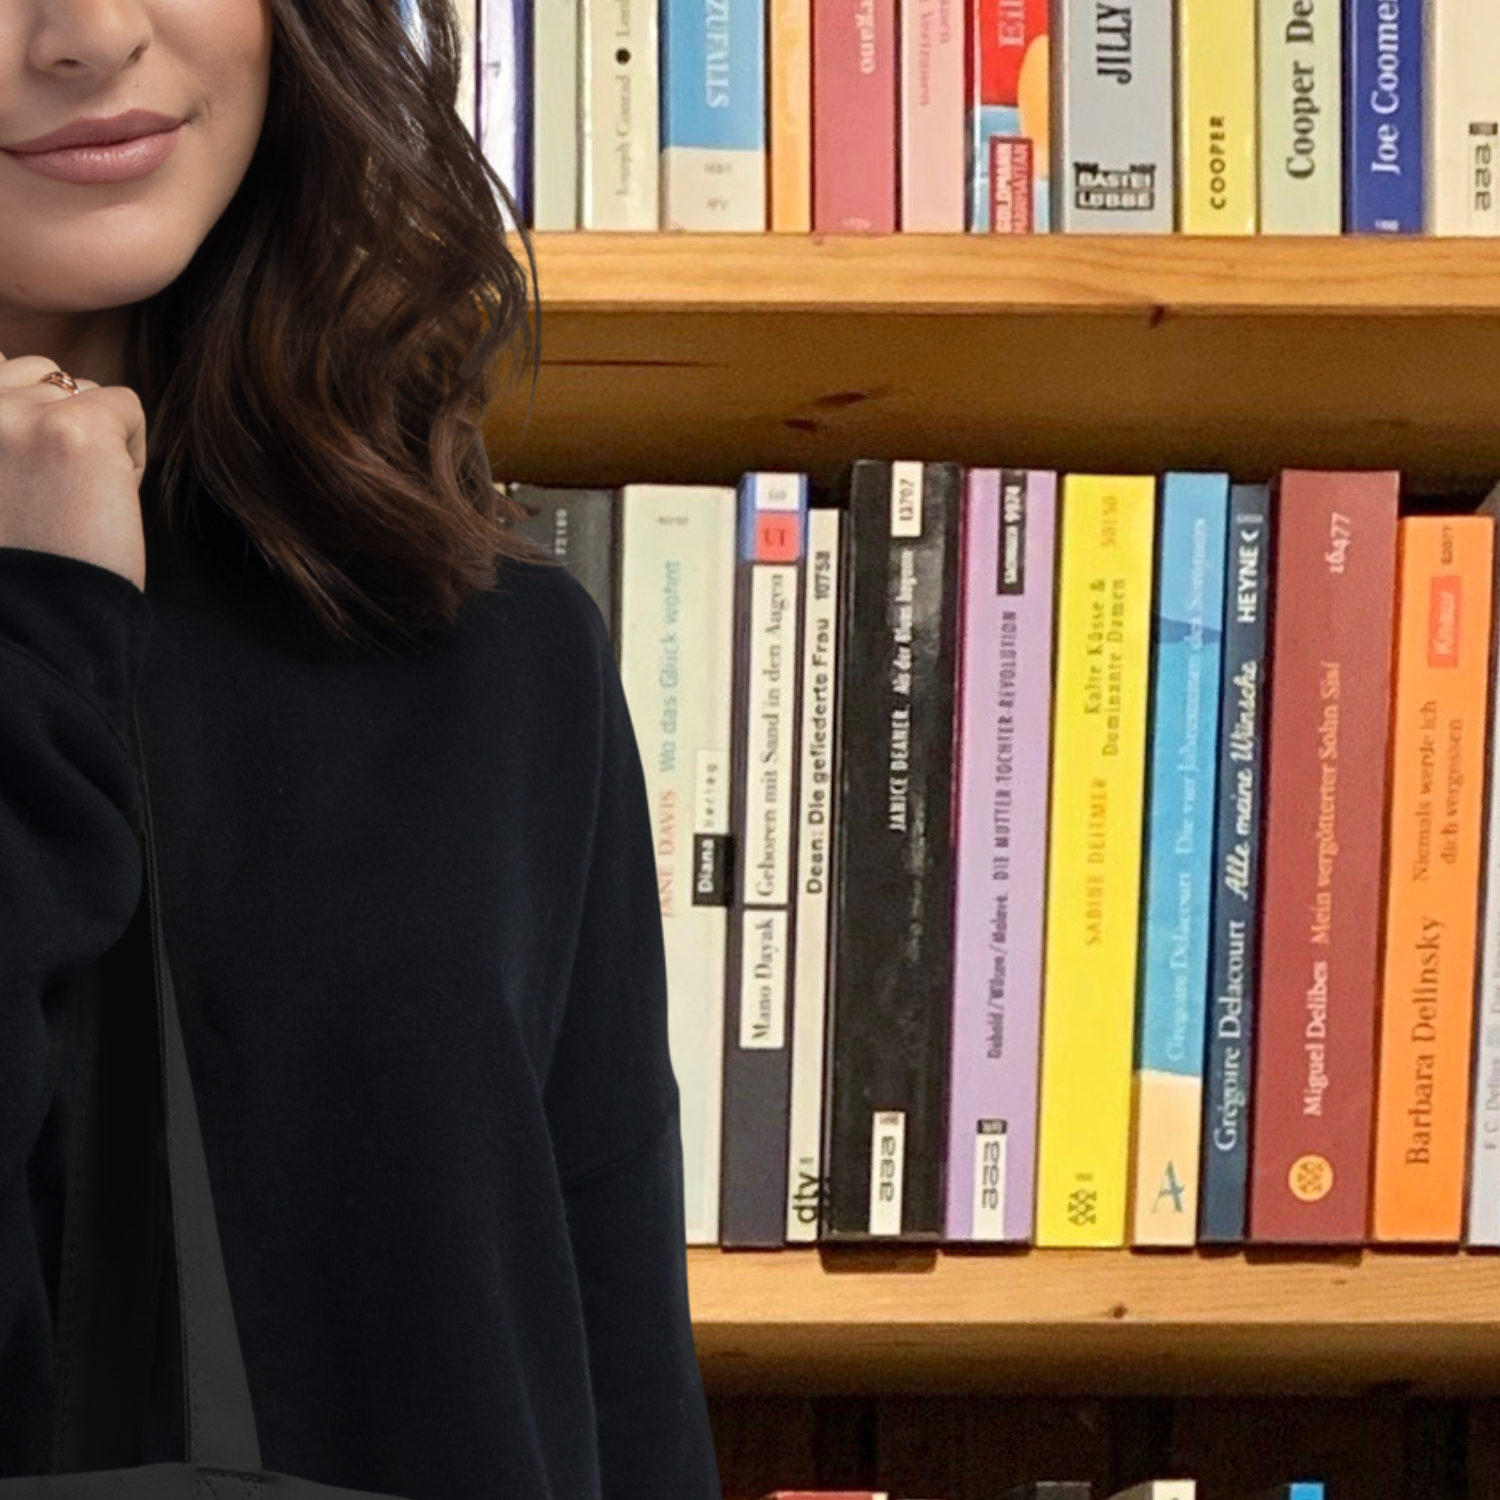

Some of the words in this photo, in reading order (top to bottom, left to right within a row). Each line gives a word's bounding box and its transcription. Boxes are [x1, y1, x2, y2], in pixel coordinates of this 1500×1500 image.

[1096, 3, 1132, 84] JILLY
[1285, 60, 1320, 179] Cooper
[1370, 125, 1401, 174] Joe
[1078, 172, 1152, 188] BASTEI
[1209, 116, 1226, 210] COOPER
[767, 574, 788, 640] Augen
[1238, 547, 1257, 622] HEYNE
[763, 645, 780, 682] den
[763, 689, 781, 708] in
[1230, 661, 1256, 761] Wünsche
[762, 714, 779, 763] Sand
[764, 771, 777, 802] mit
[1236, 769, 1252, 835] meine
[698, 839, 713, 892] Diana
[757, 809, 776, 897] Geboren
[1225, 842, 1249, 900] Alle
[755, 919, 773, 979] Dayak
[1218, 921, 1244, 1038] Delacourt
[1411, 921, 1440, 1042] Delinsky
[752, 986, 770, 1039] Mano
[1306, 961, 1327, 1038] Delibes
[1214, 1047, 1245, 1151] Grégoire
[1304, 1044, 1328, 1115] Miguel
[1406, 1052, 1434, 1165] Barbara
[792, 1172, 821, 1224] dtv
